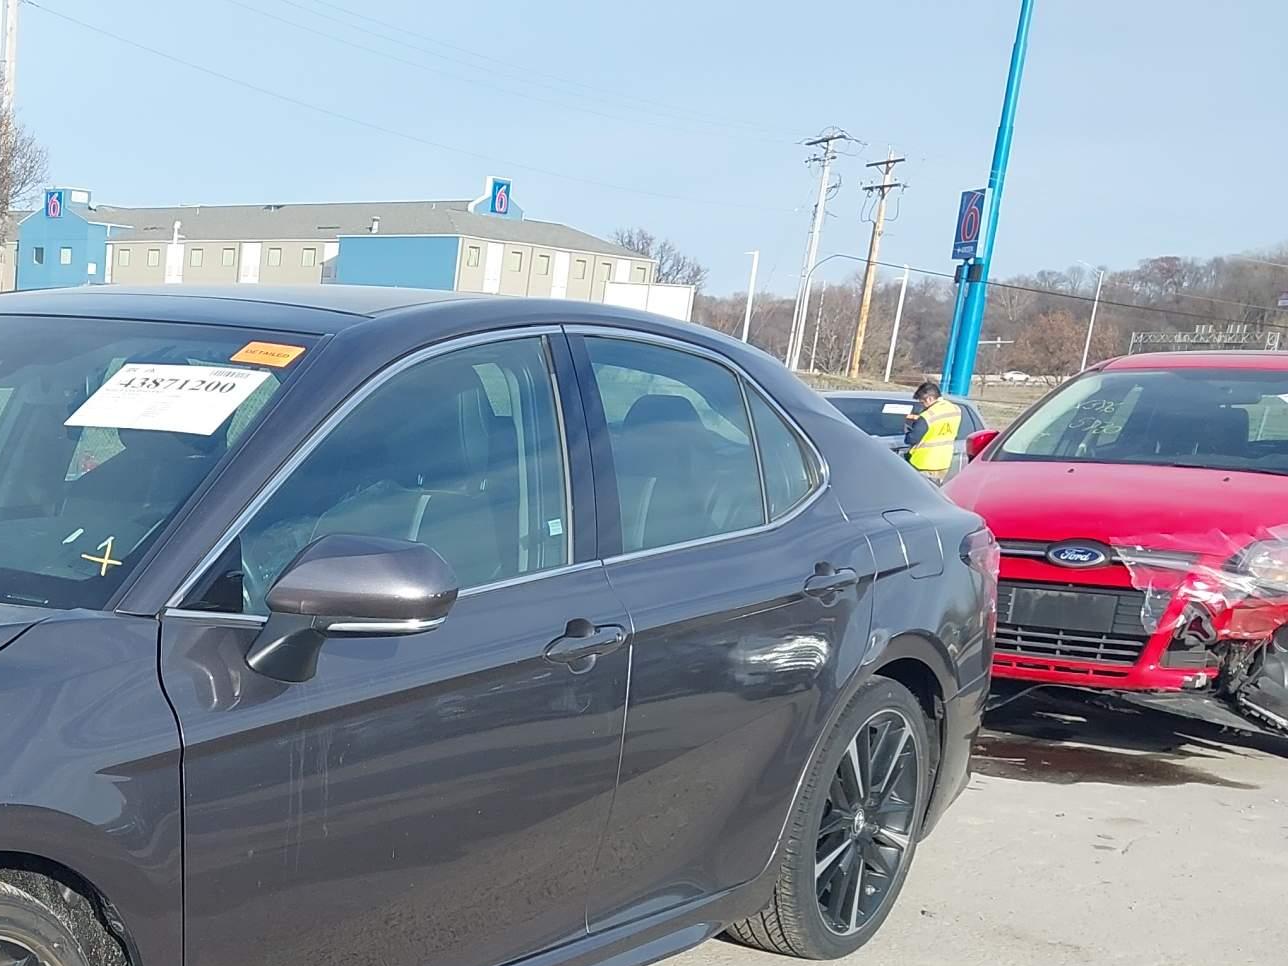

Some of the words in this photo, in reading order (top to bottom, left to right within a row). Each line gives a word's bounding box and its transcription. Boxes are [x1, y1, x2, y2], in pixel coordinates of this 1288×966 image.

[48, 193, 60, 217] 6
[496, 185, 507, 214] 6
[961, 192, 980, 243] 6
[245, 349, 290, 359] DETAILED
[120, 376, 236, 394] 43871200
[1060, 548, 1091, 561] Ford
